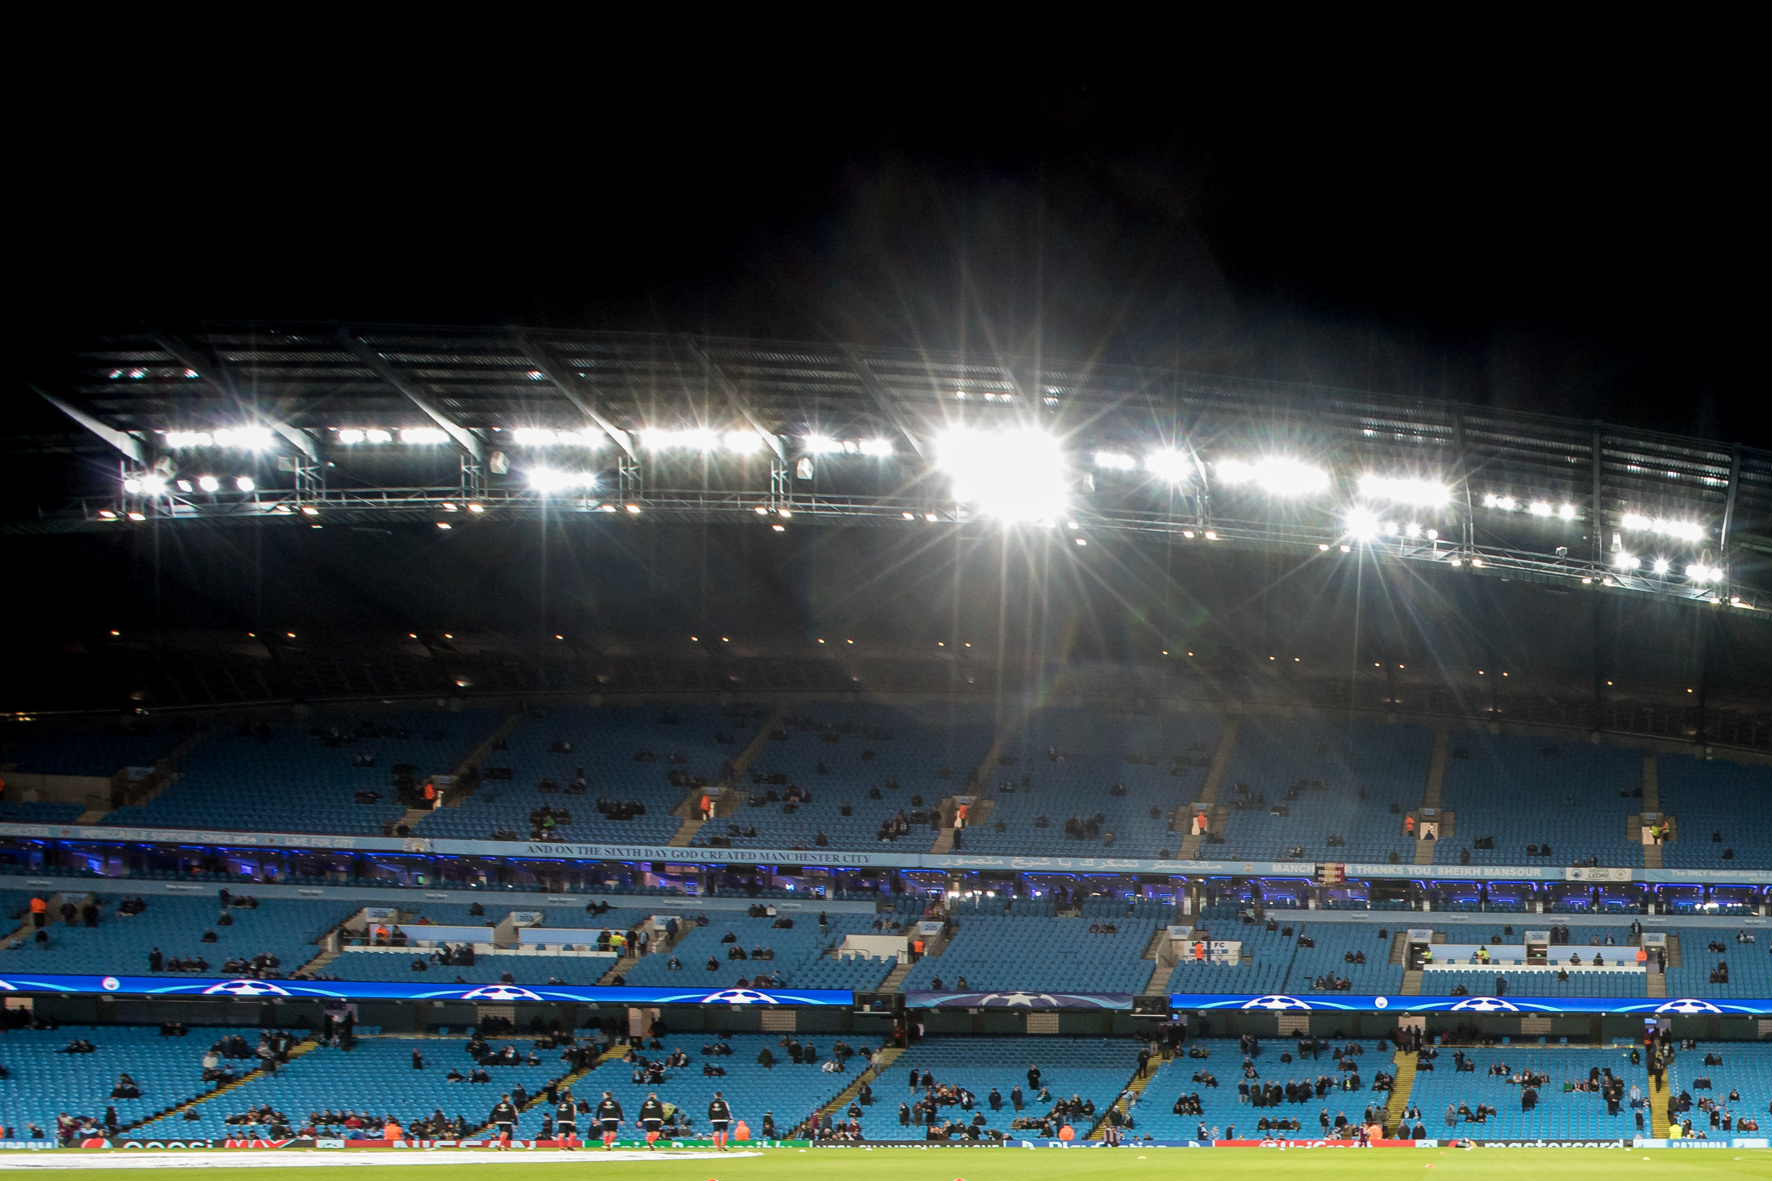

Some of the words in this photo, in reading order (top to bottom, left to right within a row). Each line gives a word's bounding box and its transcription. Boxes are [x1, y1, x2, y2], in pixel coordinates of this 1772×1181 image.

[527, 845, 552, 854] AND
[555, 846, 573, 855] ON
[577, 846, 602, 856] THE
[604, 847, 641, 857] SIXTH
[645, 849, 667, 858] DAY
[671, 850, 698, 859] GOD
[701, 851, 756, 860] CREATED
[759, 853, 840, 863] MANCHESTER
[843, 854, 871, 863] CITY
[1272, 863, 1353, 875] MANCHR
[1356, 865, 1404, 875] THANKS
[1406, 866, 1433, 876] YOU,
[1437, 866, 1481, 876] SHEIKH
[1484, 867, 1541, 877] MANSOUR
